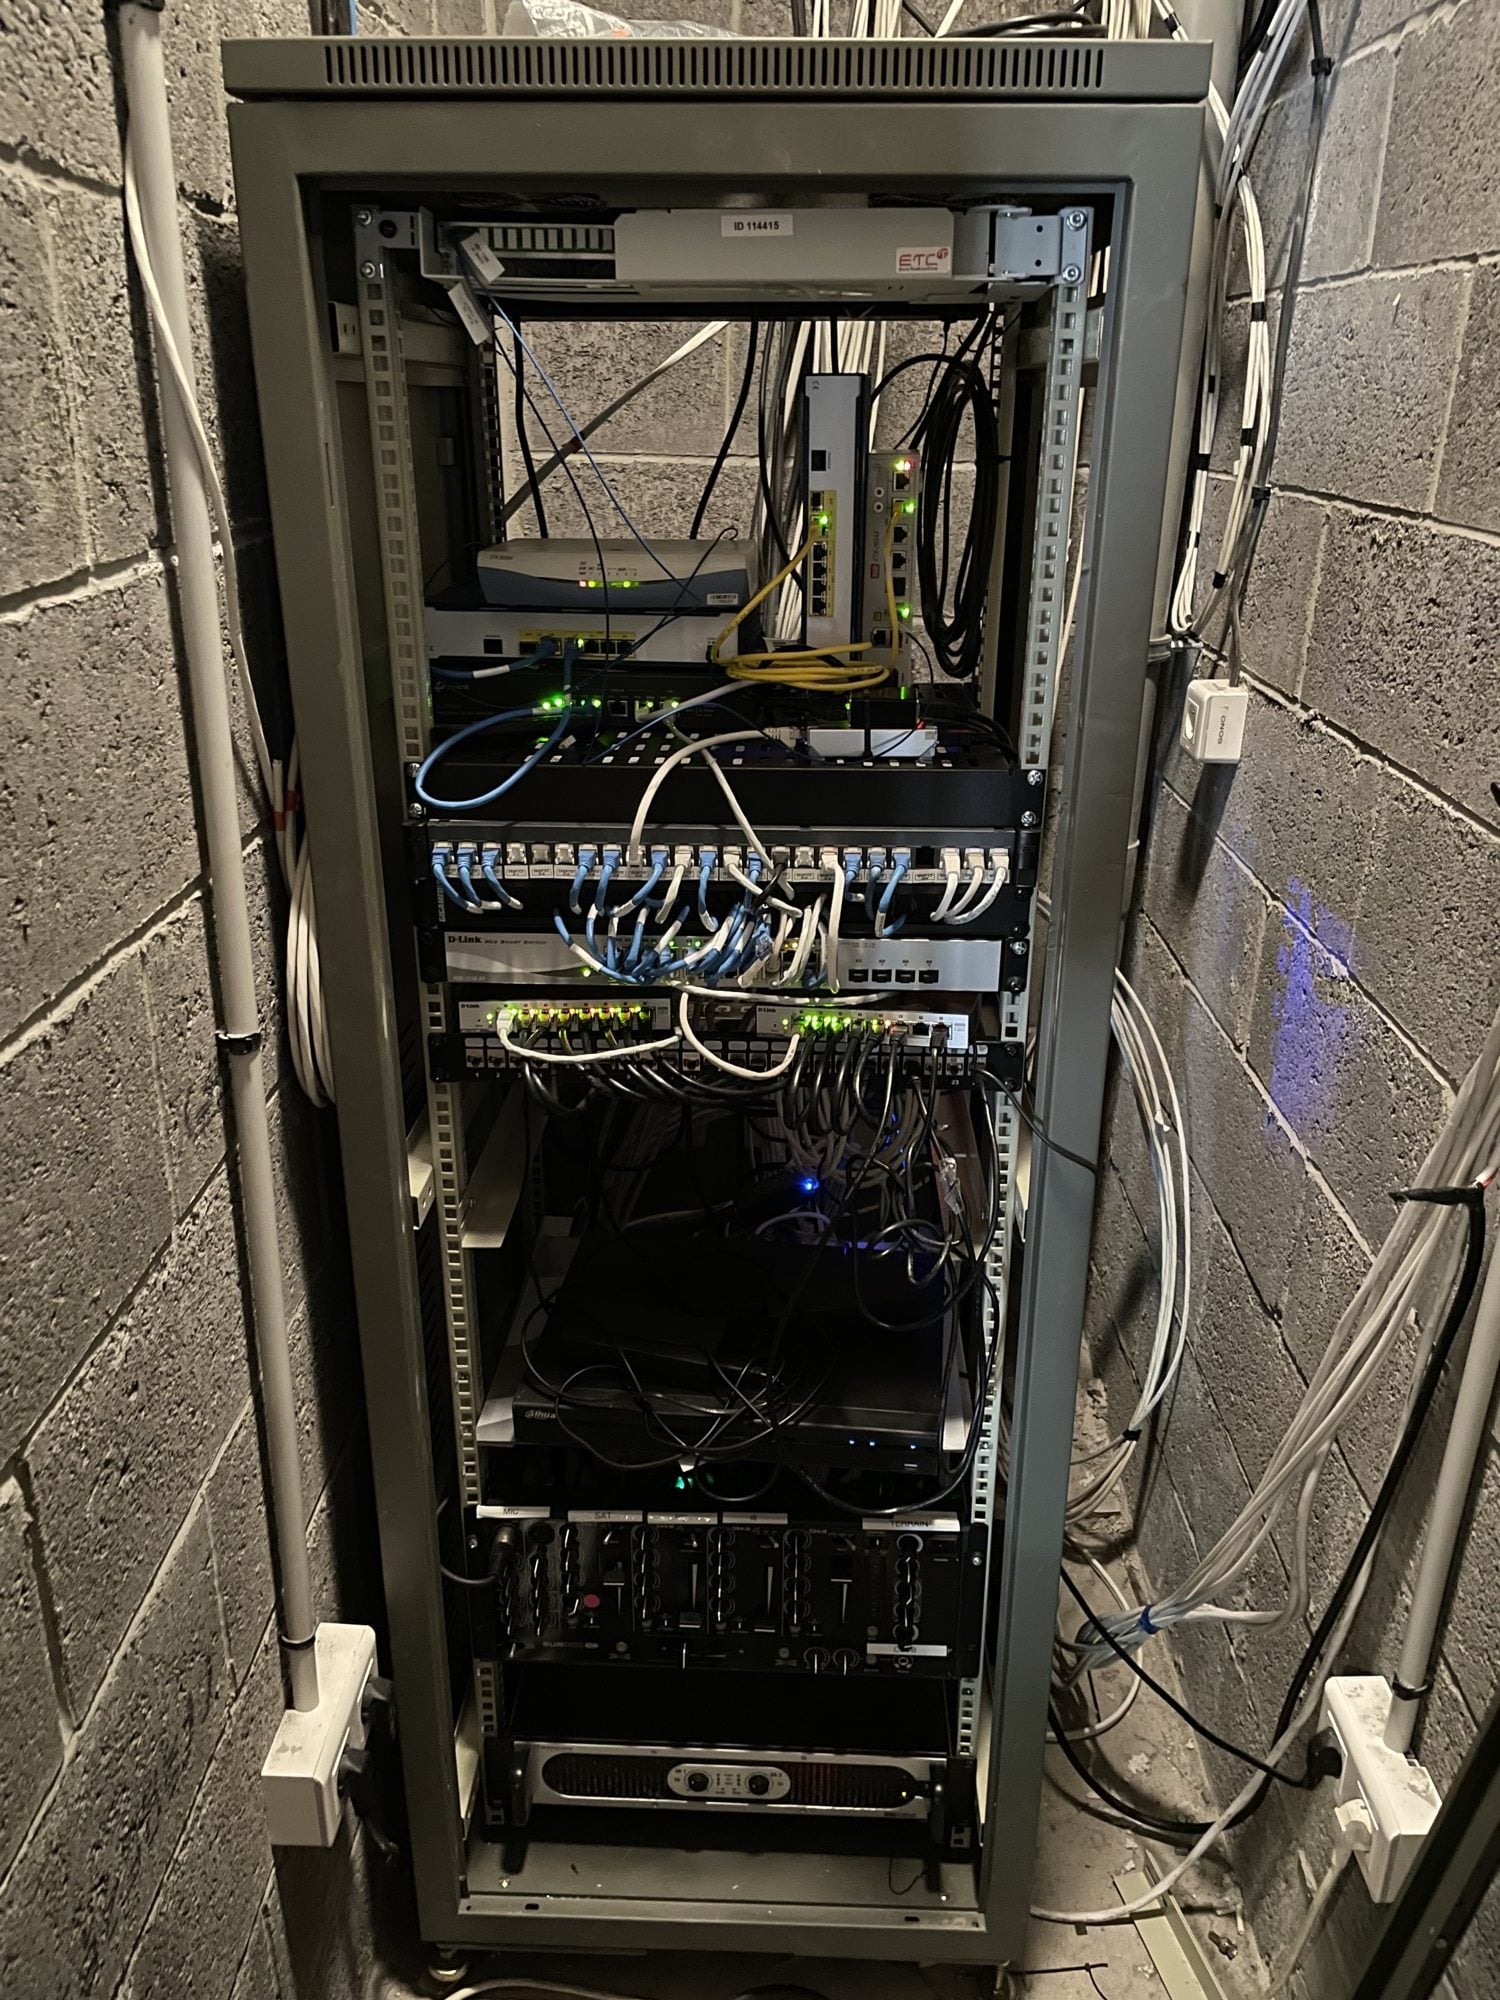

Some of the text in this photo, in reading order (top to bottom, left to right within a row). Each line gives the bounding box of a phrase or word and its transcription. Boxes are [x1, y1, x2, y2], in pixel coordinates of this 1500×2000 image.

[734, 221, 779, 231] ID 114415
[448, 935, 482, 944] D-Link
[594, 1512, 611, 1520] SAT
[890, 1520, 929, 1528] TERRAIN
